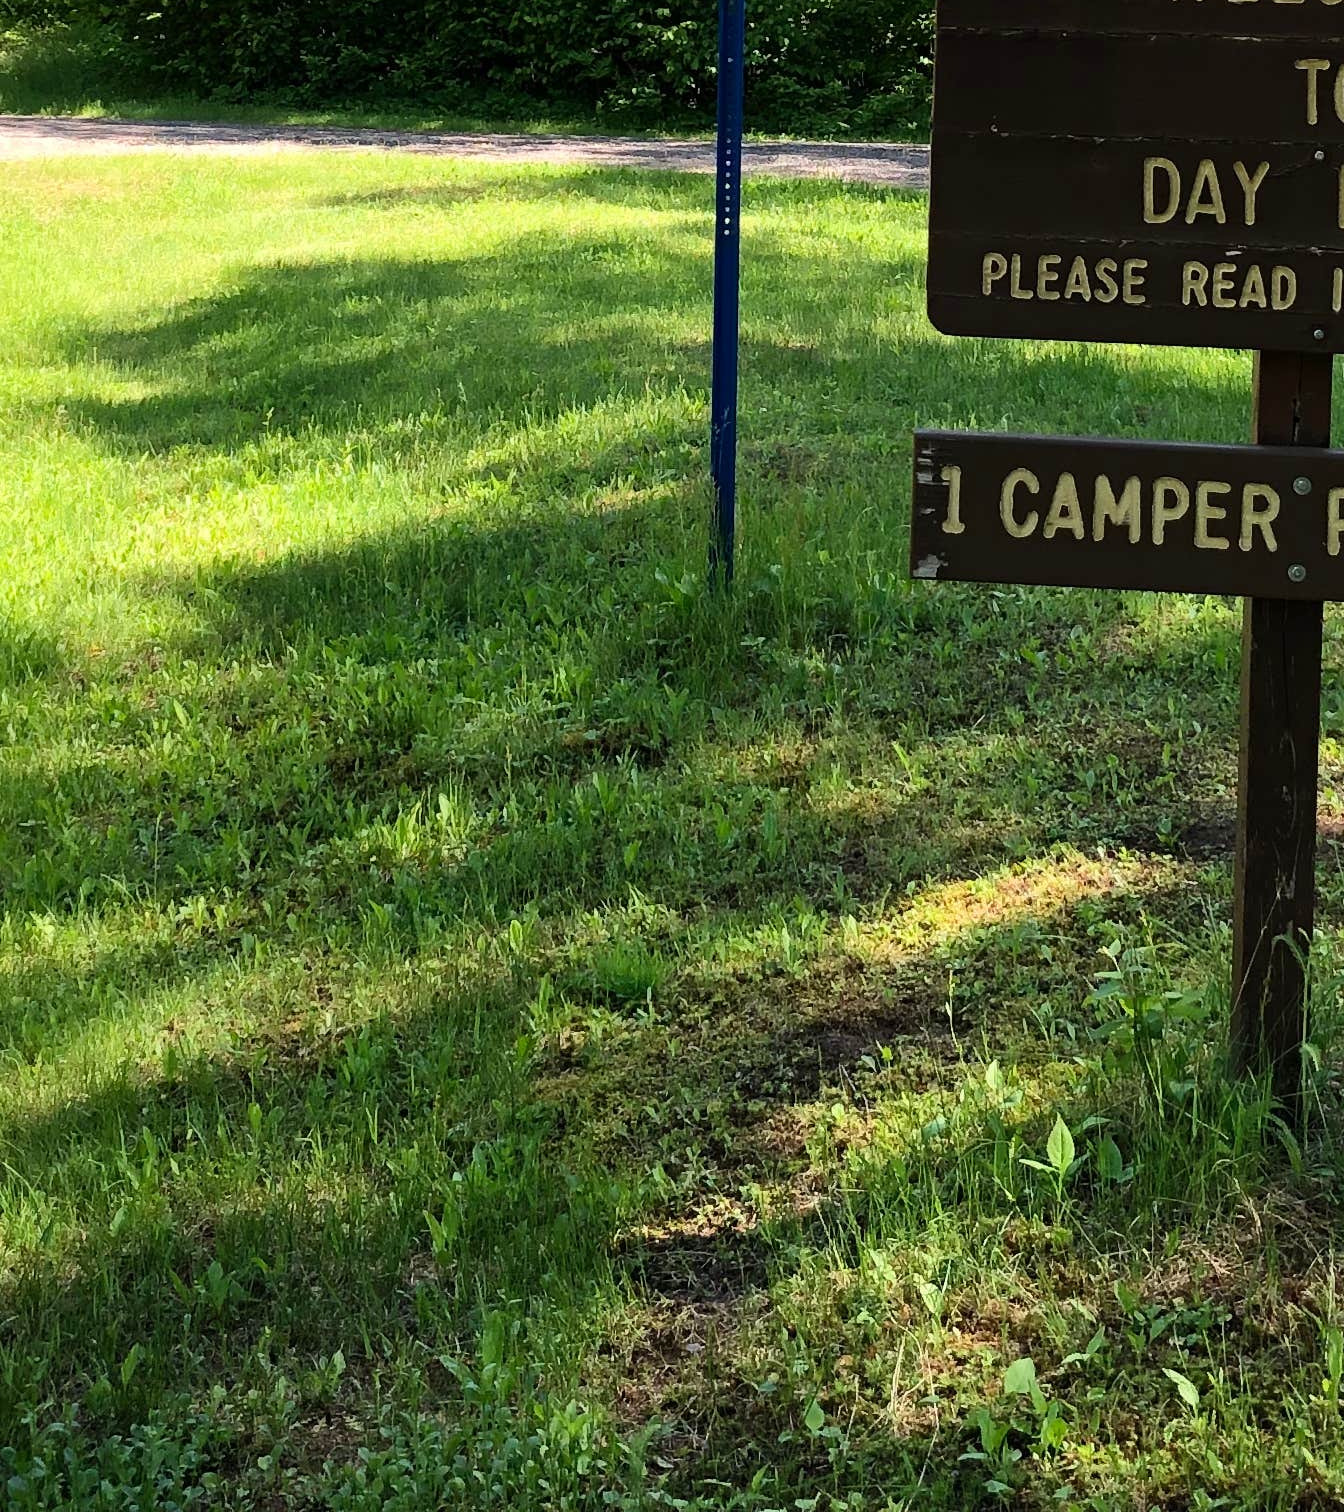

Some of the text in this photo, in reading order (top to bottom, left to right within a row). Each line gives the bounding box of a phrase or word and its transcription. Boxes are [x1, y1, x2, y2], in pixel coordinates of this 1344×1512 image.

[1143, 157, 1270, 226] DAY
[982, 252, 1148, 305] PLEASE
[1182, 261, 1297, 311] READ
[941, 465, 966, 535] 1
[999, 467, 1281, 553] CAMPER
